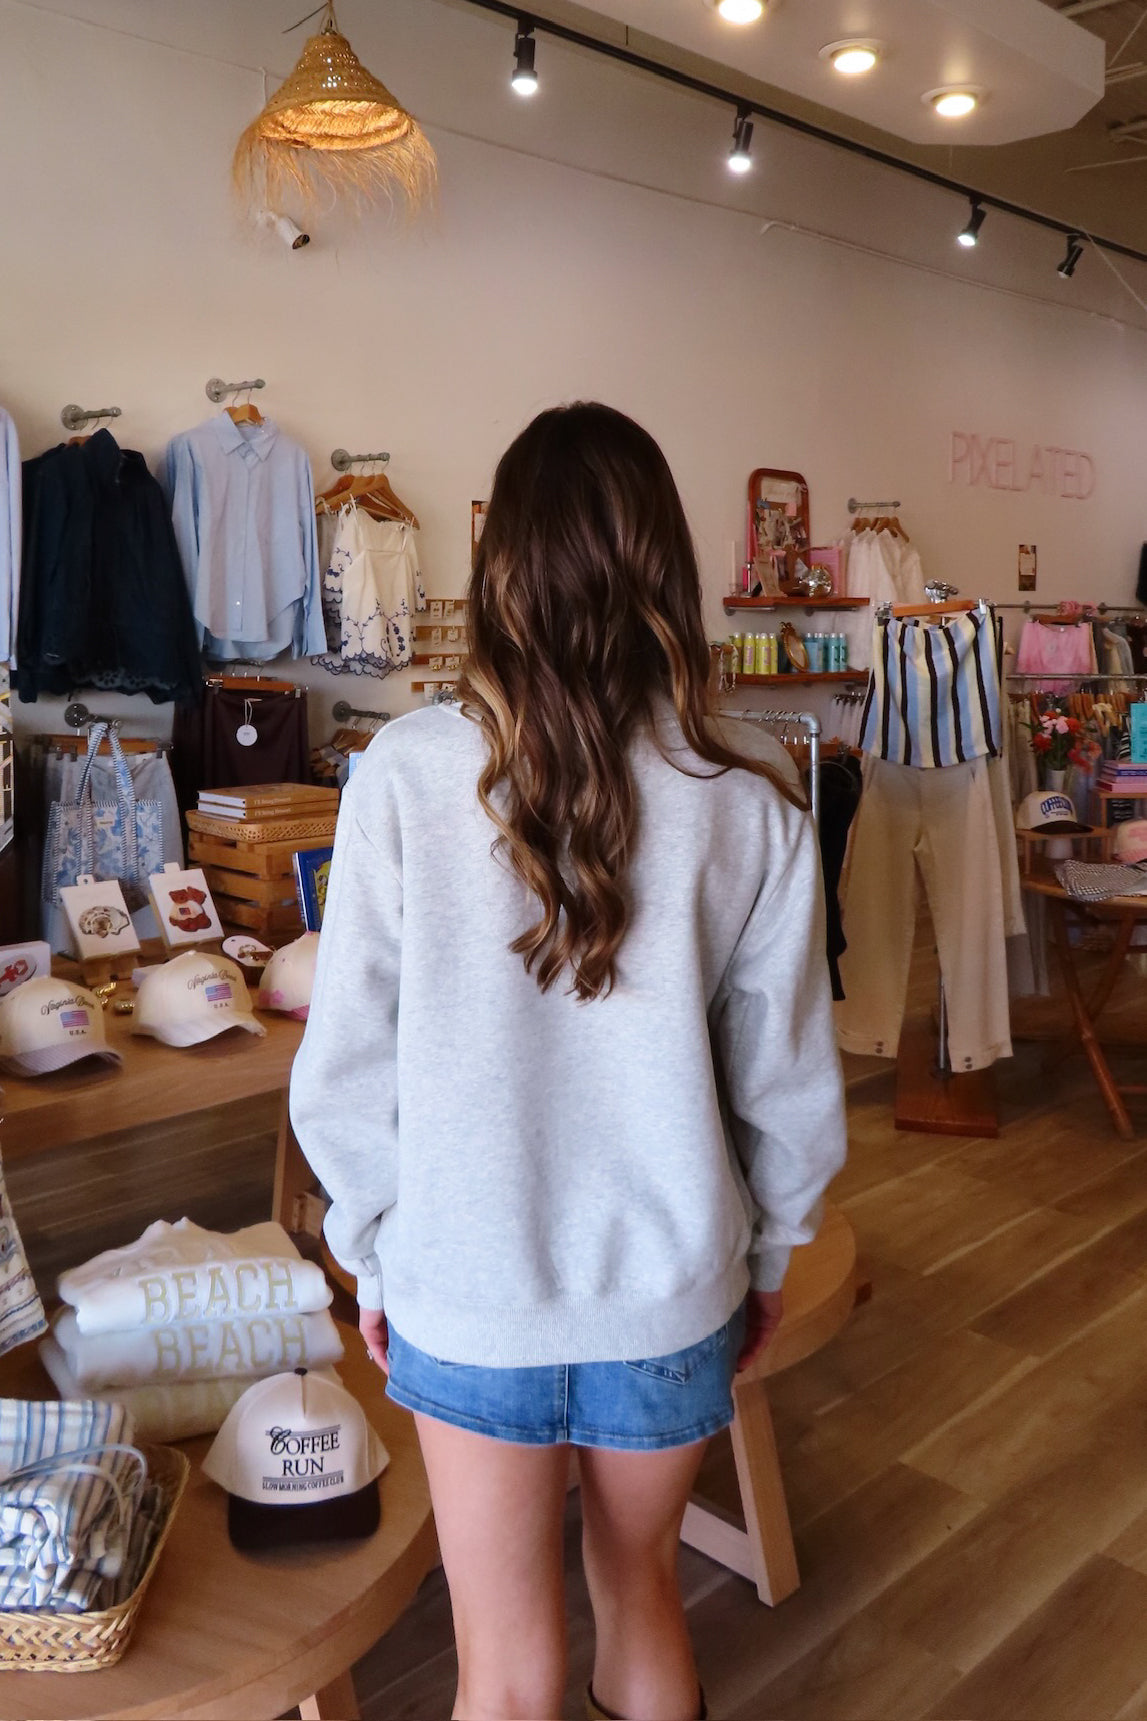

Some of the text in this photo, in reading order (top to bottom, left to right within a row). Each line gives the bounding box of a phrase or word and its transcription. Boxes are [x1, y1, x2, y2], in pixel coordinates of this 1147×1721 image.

[138, 1262, 298, 1322] BEACH
[153, 1318, 309, 1373] BEACH
[269, 1426, 340, 1455] COFFEE
[282, 1457, 325, 1477] RUN
[307, 1478, 330, 1490] COFFEE
